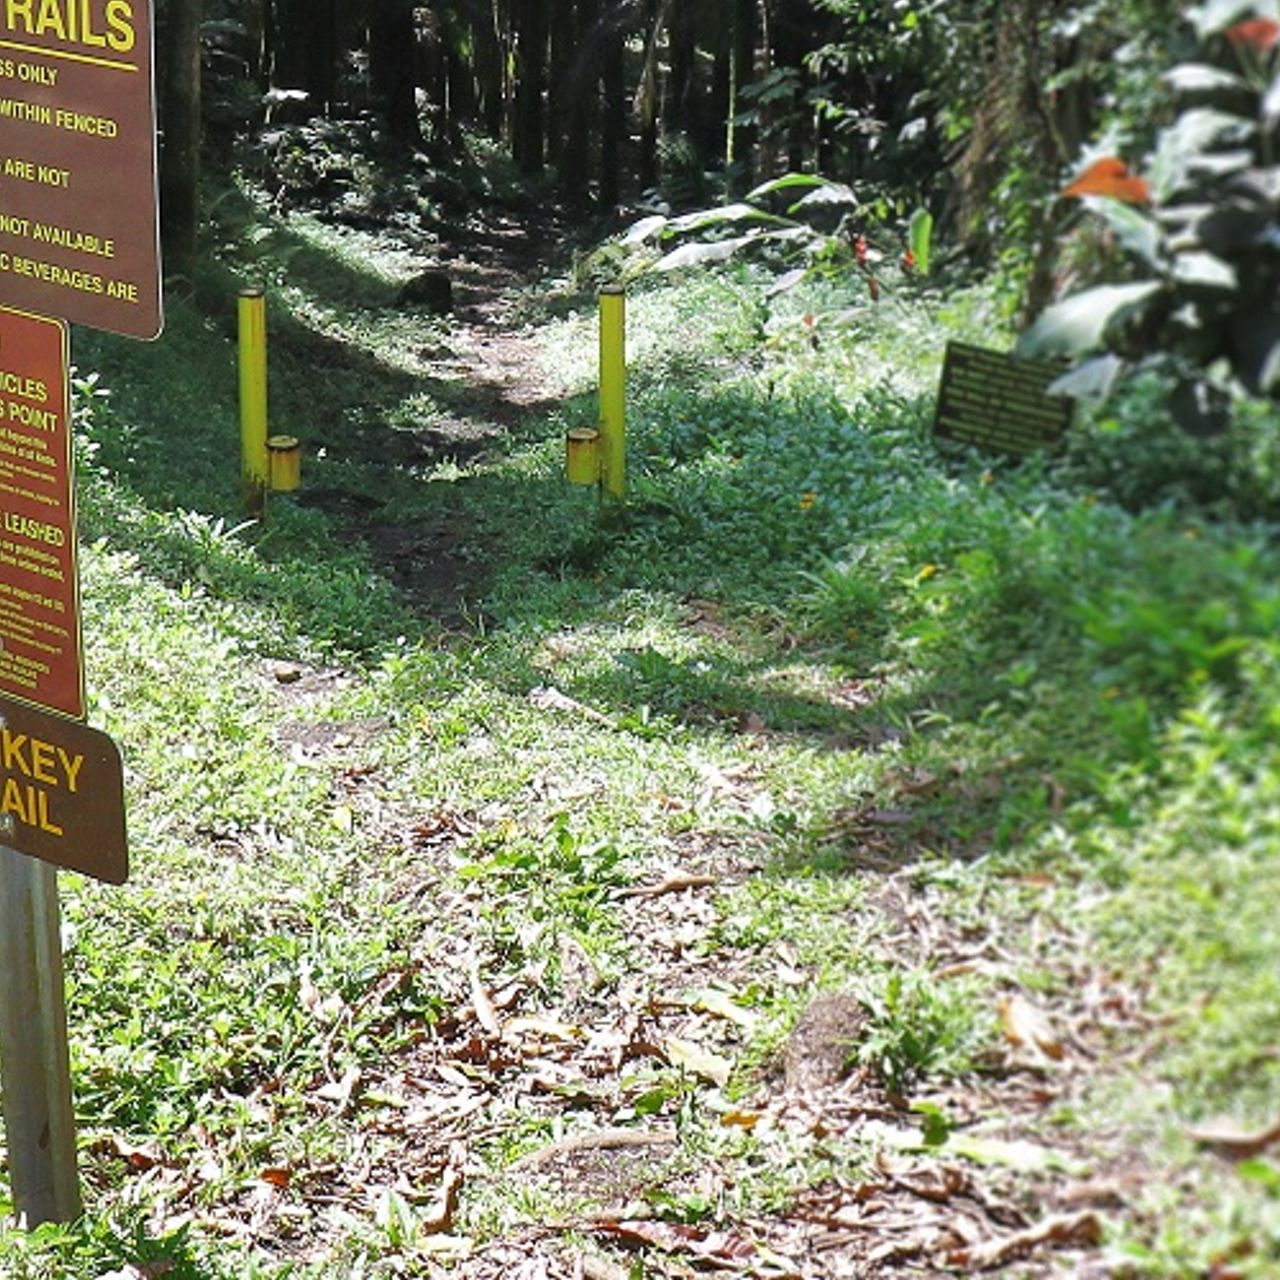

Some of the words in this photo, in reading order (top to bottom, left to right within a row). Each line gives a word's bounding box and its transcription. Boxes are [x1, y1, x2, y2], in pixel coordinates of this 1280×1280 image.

[18, 64, 58, 85] ONLY
[56, 110, 117, 137] FENCED
[5, 159, 35, 181] ARE
[39, 166, 69, 188] NOT
[0, 215, 30, 237] NOT
[33, 223, 114, 257] AVAILABLE
[13, 257, 103, 293] BEVERAGES
[107, 281, 138, 303] ARE
[10, 403, 58, 432] POINT
[5, 512, 65, 546] LEASHED
